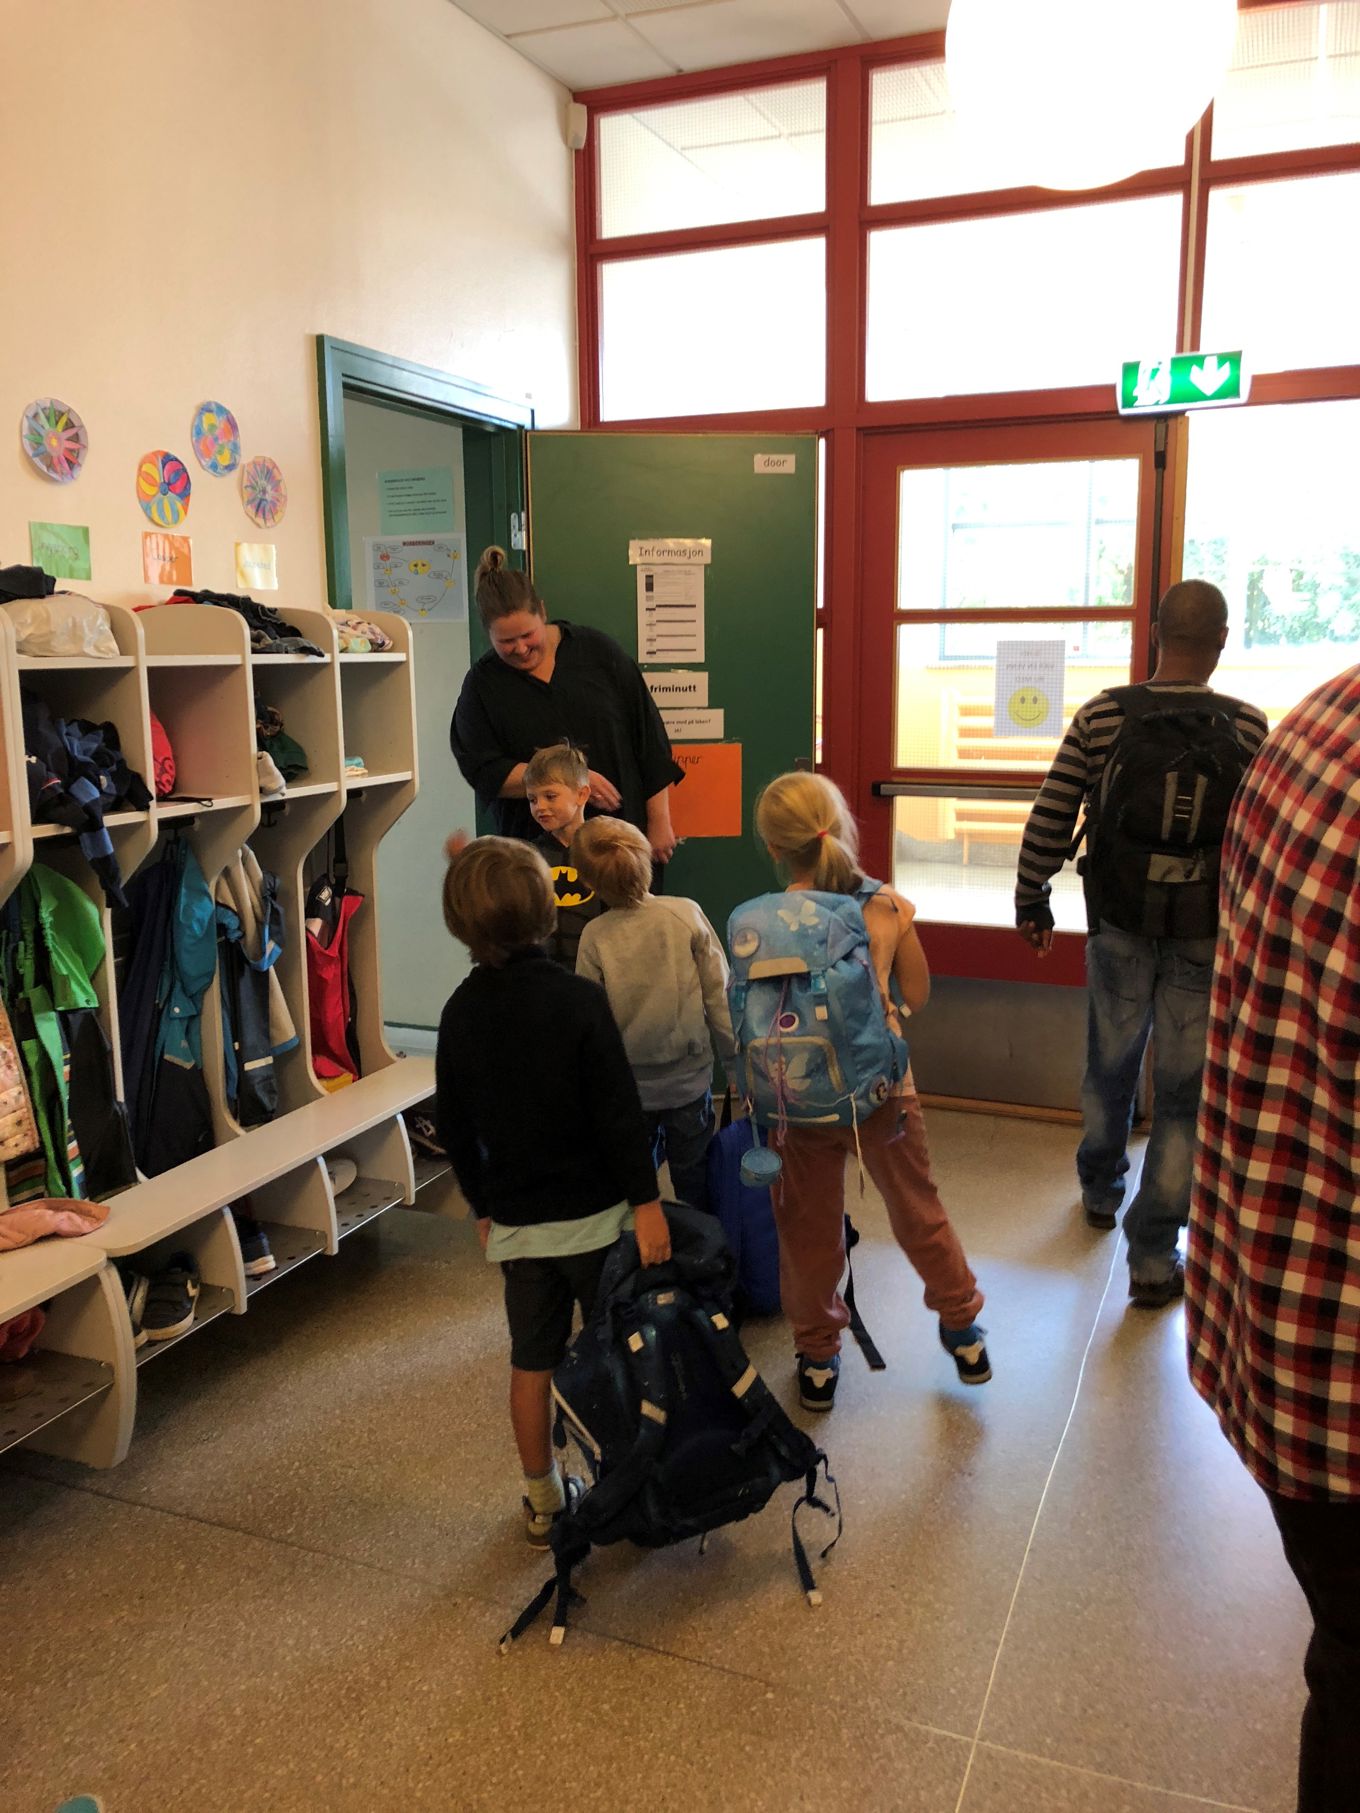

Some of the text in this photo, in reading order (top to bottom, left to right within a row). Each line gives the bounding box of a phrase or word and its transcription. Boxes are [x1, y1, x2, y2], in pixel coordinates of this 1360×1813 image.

[763, 456, 788, 468] door
[639, 546, 704, 560] Informasjon
[649, 684, 697, 693] friminutt
